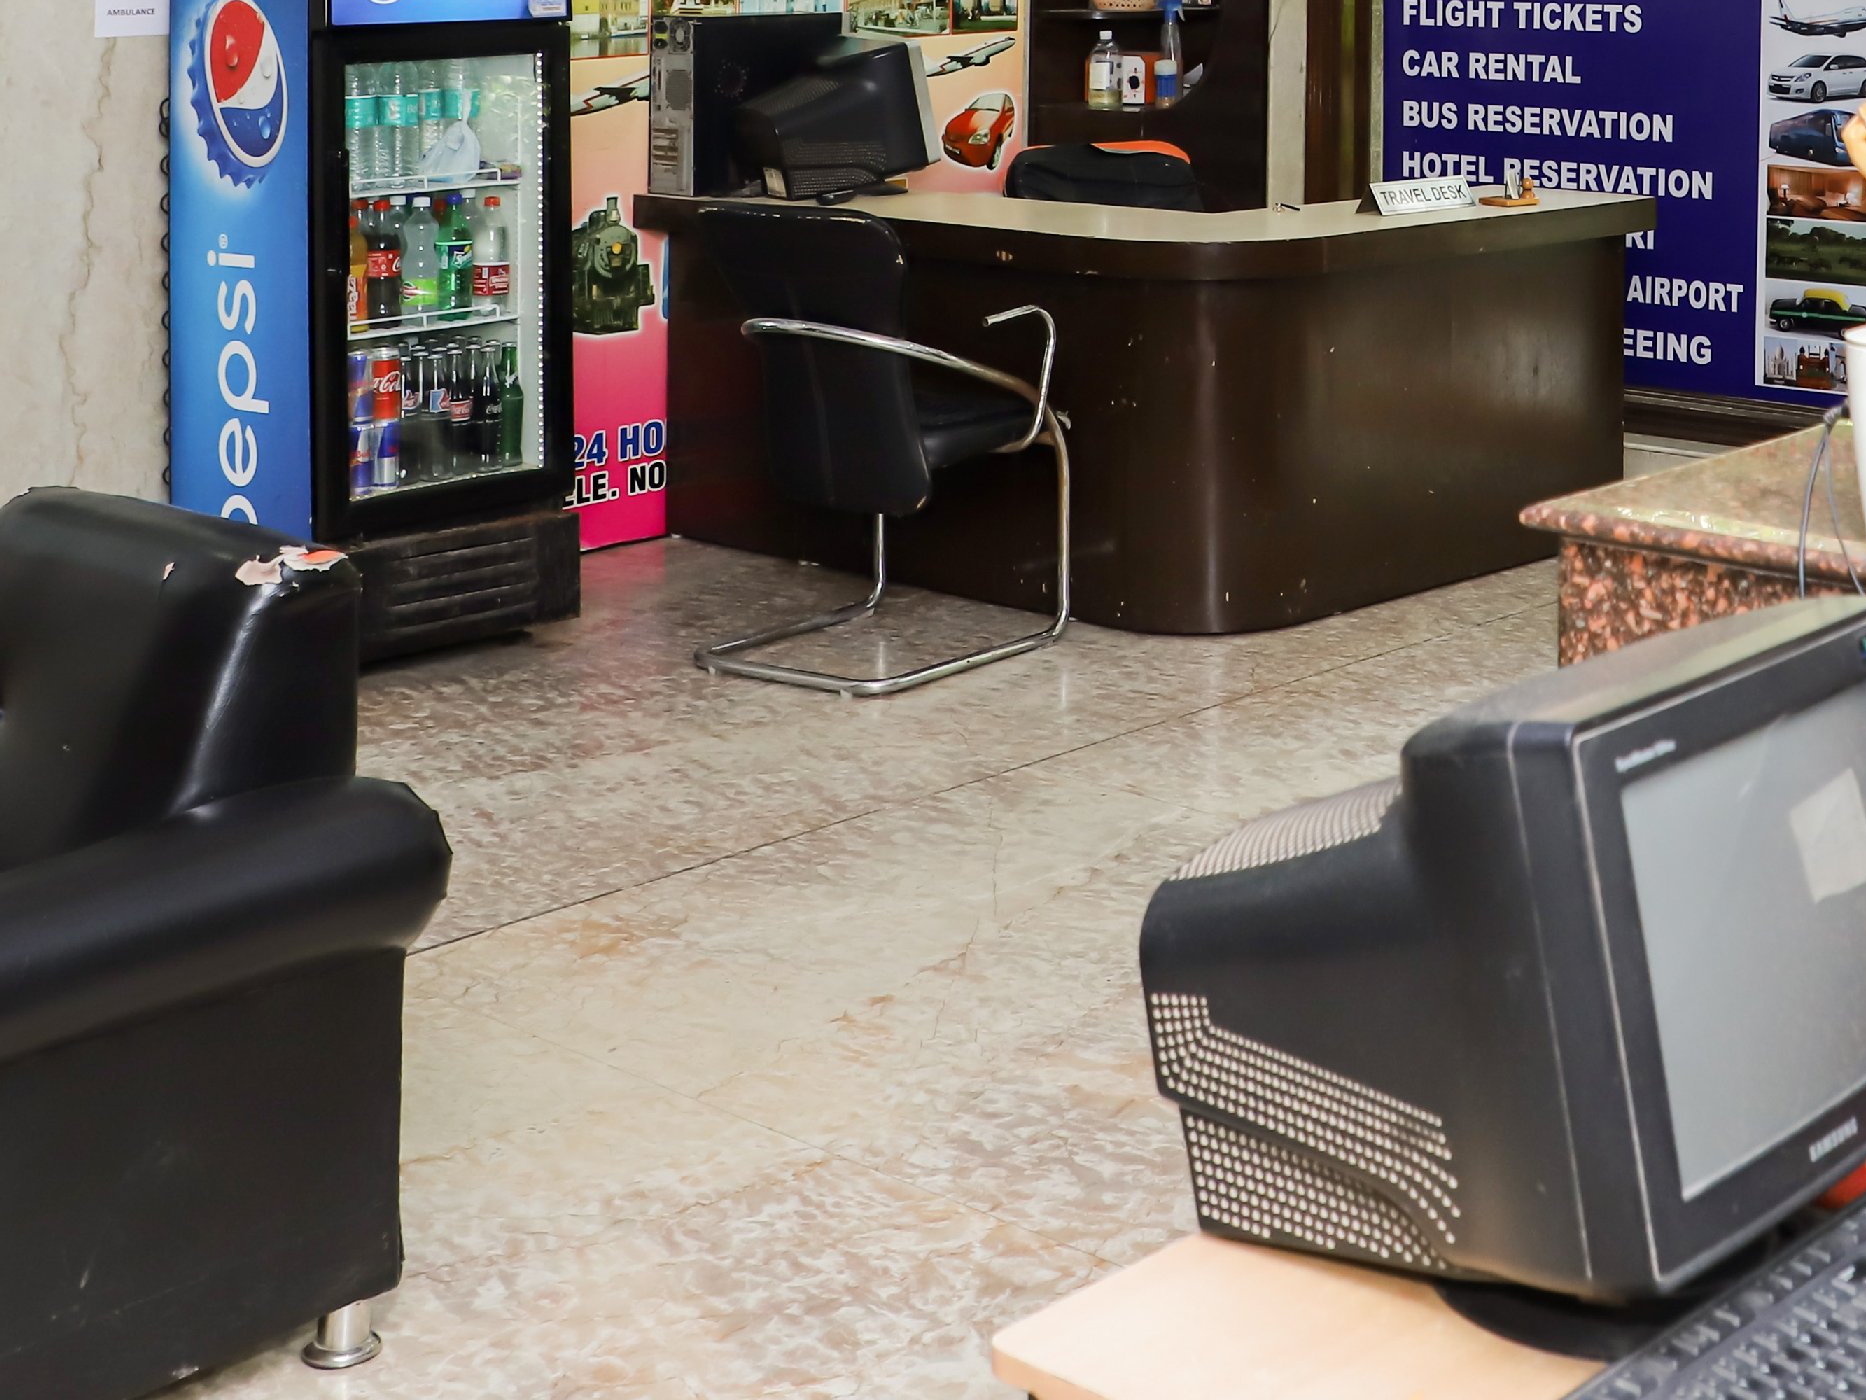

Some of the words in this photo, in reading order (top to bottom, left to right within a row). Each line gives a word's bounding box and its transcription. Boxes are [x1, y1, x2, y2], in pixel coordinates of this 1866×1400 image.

[106, 8, 155, 16] AMBULANCE
[1402, 0, 1504, 28] FLIGHT
[1513, 2, 1642, 34] TICKETS
[1402, 49, 1459, 77] CAR
[1468, 52, 1582, 84] RENTAL
[1402, 100, 1458, 130] BUS
[1467, 103, 1674, 143] RESERVATION
[1402, 151, 1494, 183] HOTEL
[1503, 157, 1713, 200] RESERVATION
[1380, 188, 1431, 206] TRAVEL
[1431, 184, 1467, 201] DESK
[1627, 275, 1744, 312] AIRPORT
[207, 250, 268, 525] pepsi
[574, 430, 608, 470] 24
[618, 419, 666, 461] HO
[563, 471, 620, 510] LE.
